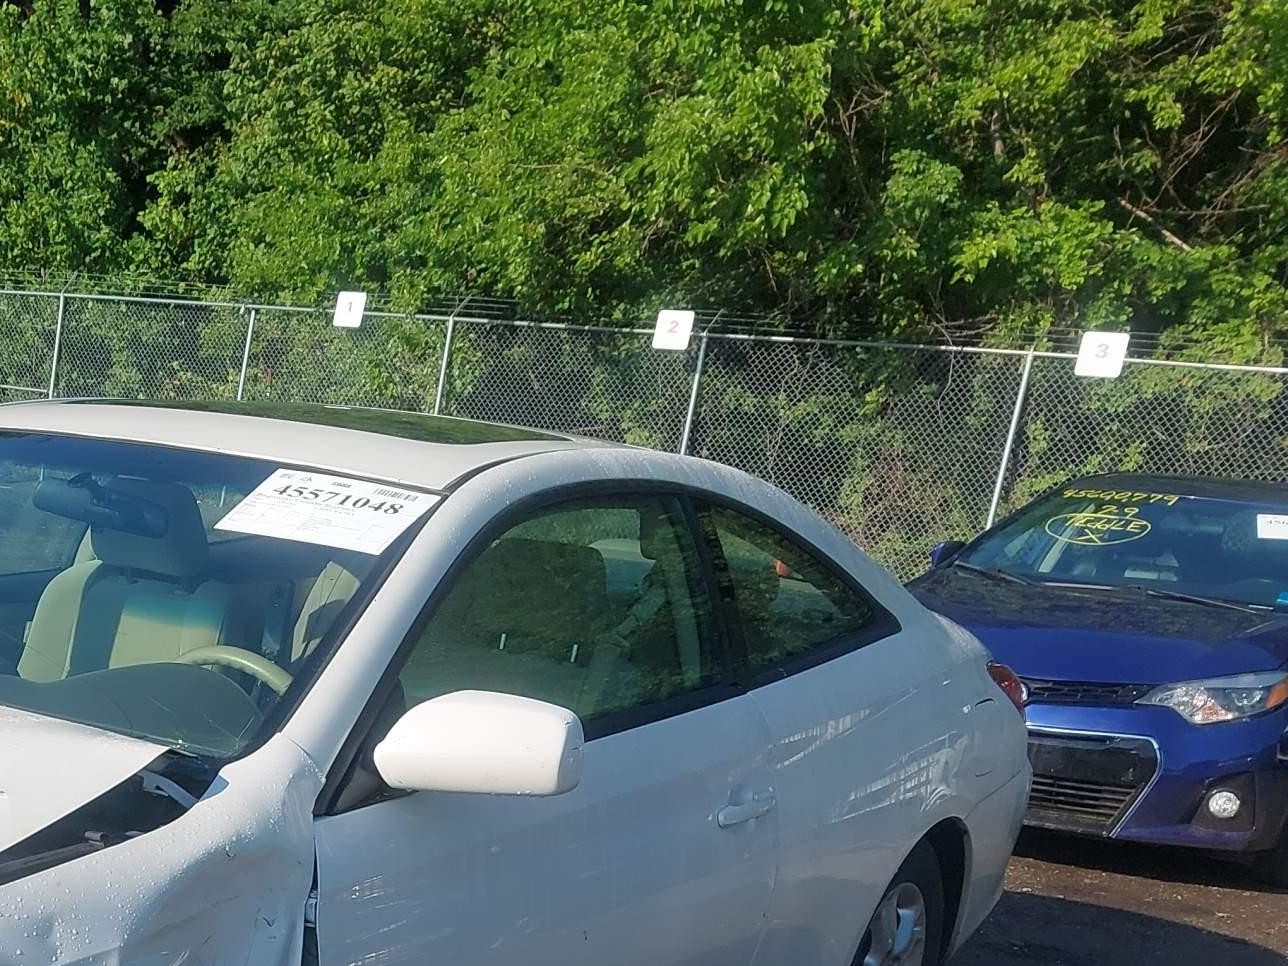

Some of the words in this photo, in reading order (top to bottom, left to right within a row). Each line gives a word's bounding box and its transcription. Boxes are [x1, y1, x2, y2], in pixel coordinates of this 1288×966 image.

[667, 320, 680, 334] 2
[1095, 343, 1110, 359] 3
[272, 484, 404, 515] 45571048
